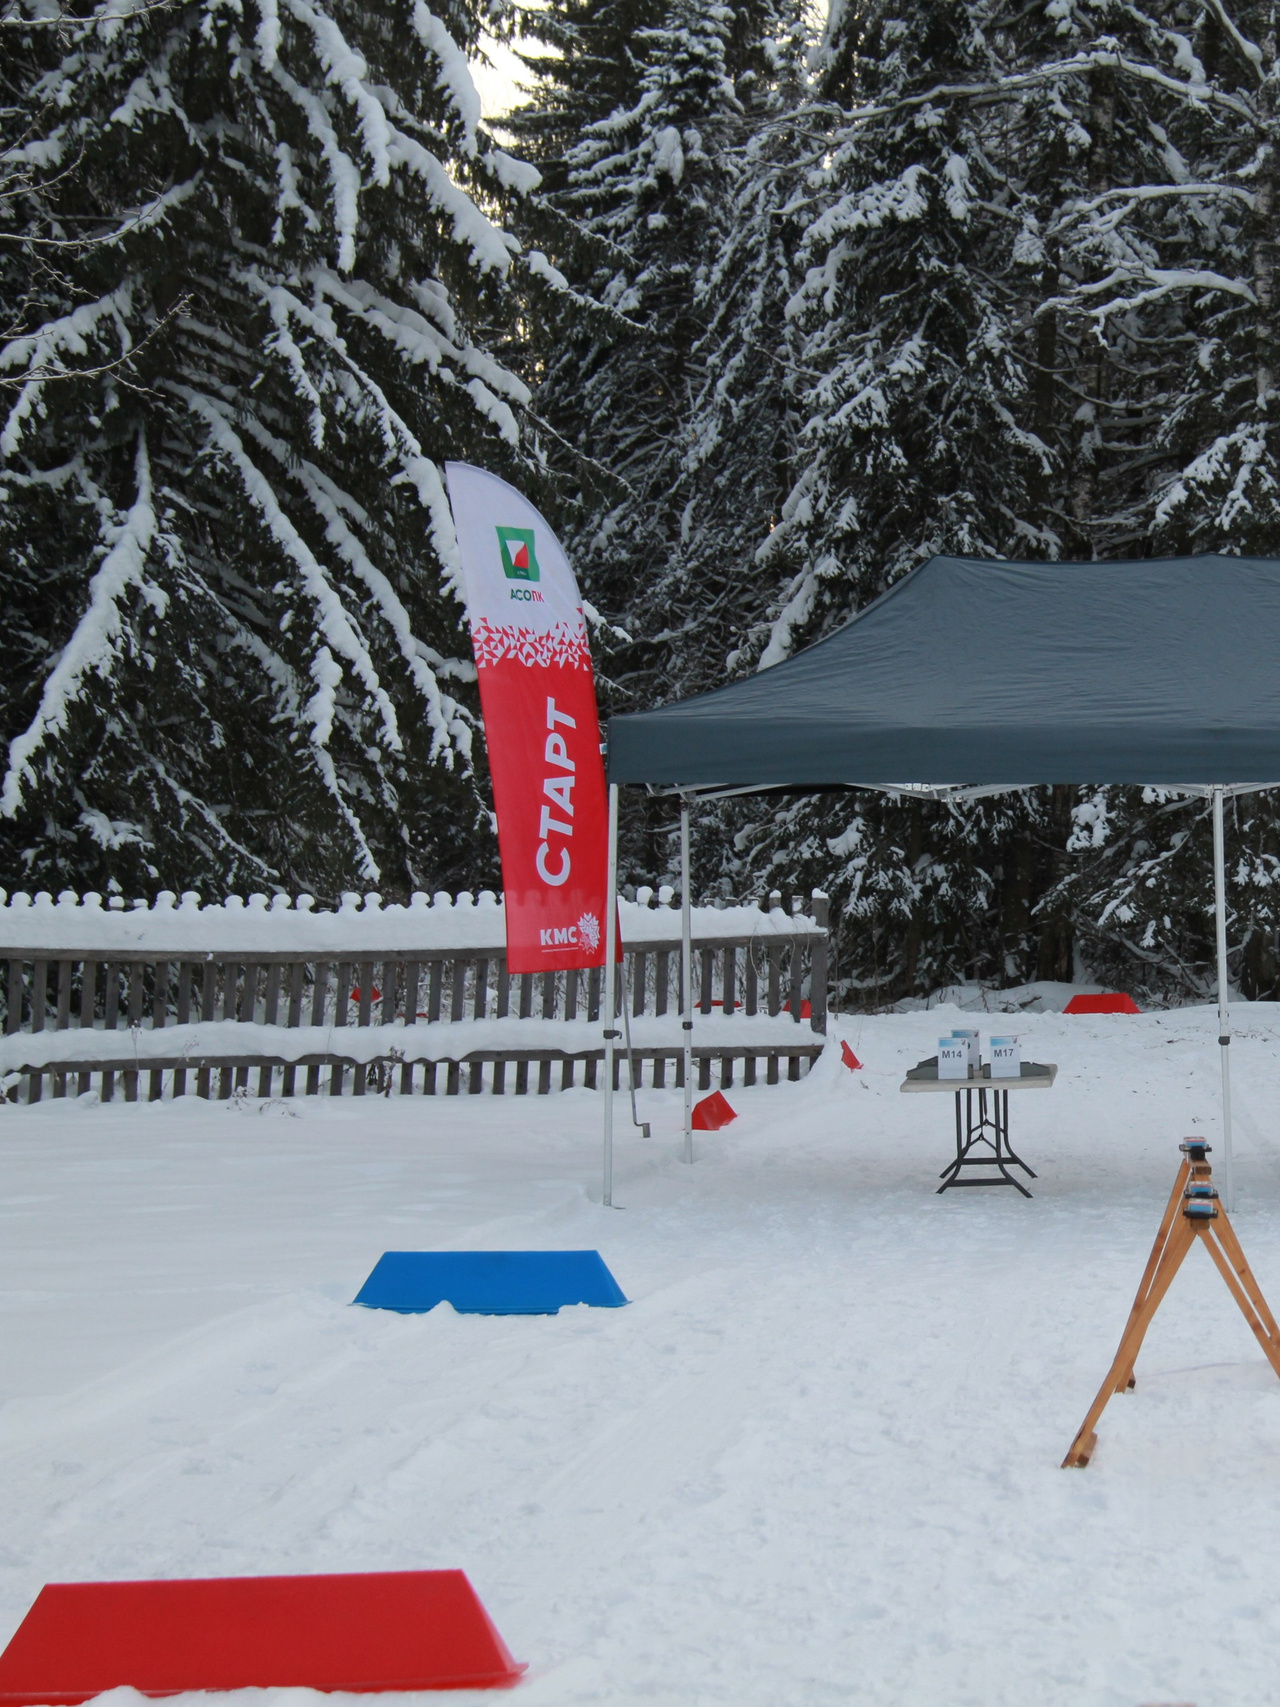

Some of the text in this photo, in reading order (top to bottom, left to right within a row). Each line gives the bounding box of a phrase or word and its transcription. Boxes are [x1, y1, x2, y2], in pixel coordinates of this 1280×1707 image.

[510, 588, 545, 602] АСОПК
[536, 696, 577, 886] СТАРТ
[540, 926, 578, 946] КМС
